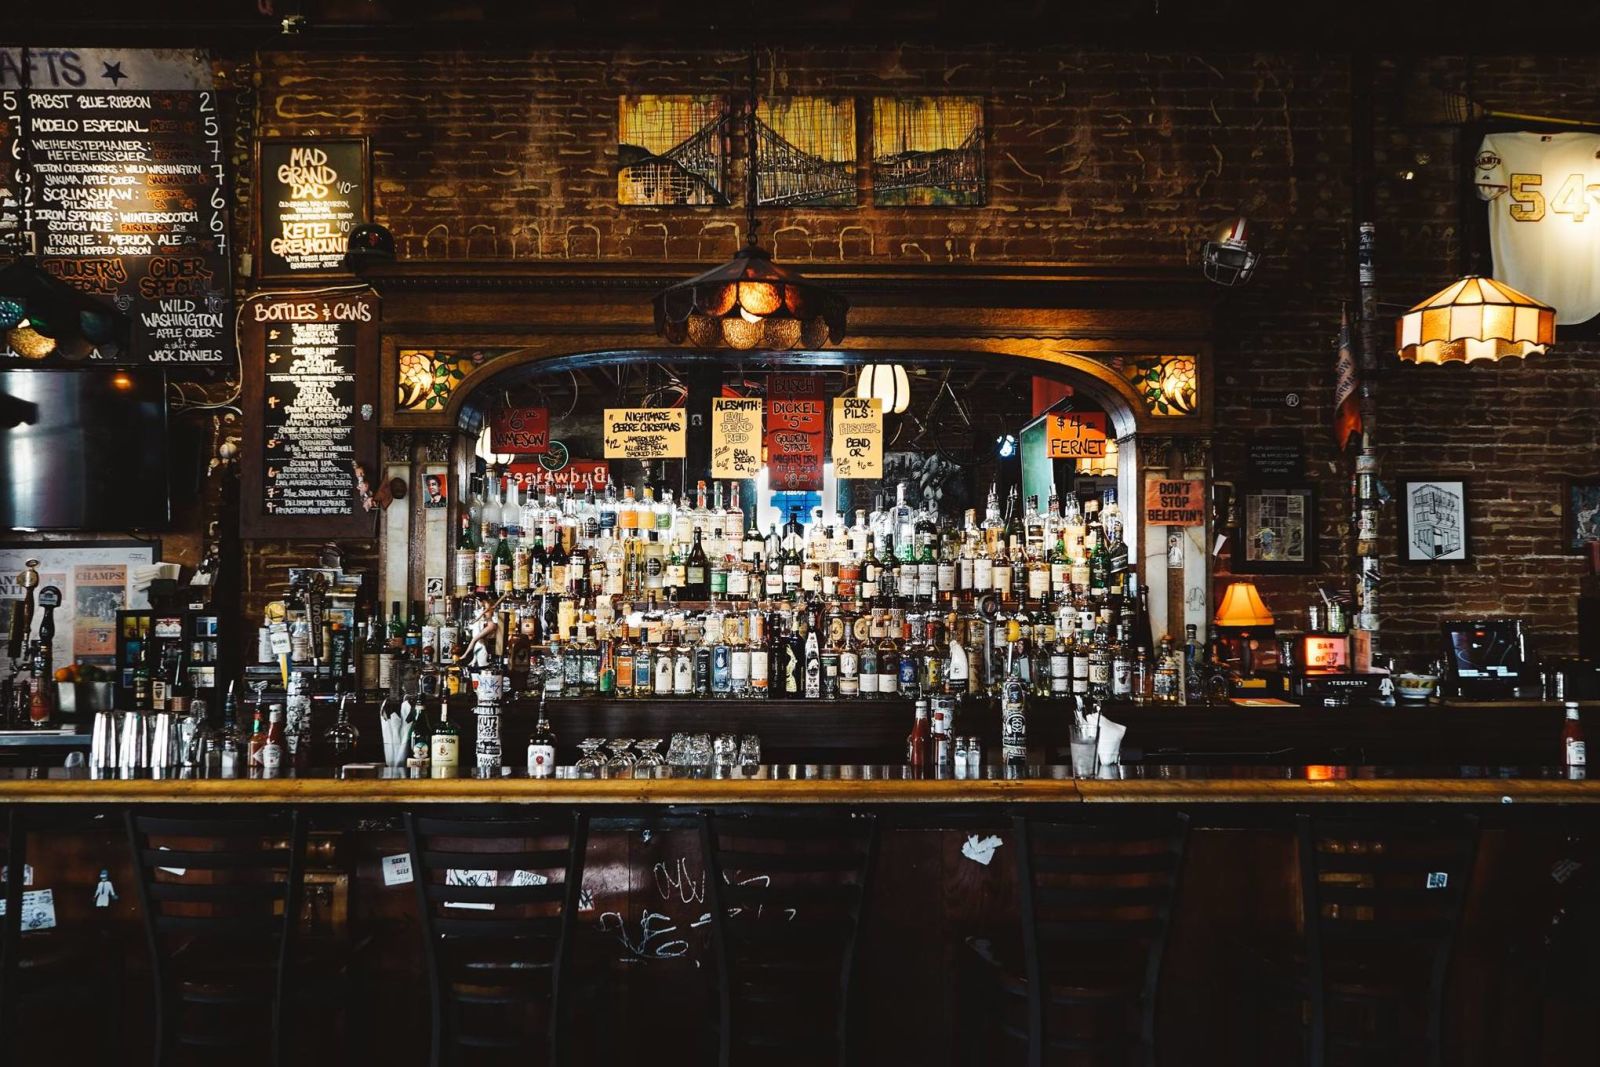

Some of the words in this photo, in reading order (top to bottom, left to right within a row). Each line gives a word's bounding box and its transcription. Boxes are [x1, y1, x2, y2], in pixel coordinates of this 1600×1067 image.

[28, 95, 73, 109] PABST
[77, 95, 107, 109] BLUE
[107, 94, 151, 109] RIBBON
[200, 92, 214, 112] 2
[31, 120, 79, 132] MODELO
[83, 120, 149, 133] ESPECIAL
[204, 117, 218, 136] 5
[47, 151, 152, 161] HEFEWEISSBIER
[206, 140, 221, 161] 7
[290, 148, 327, 167] MAD
[45, 174, 80, 186] YAKIMA
[83, 174, 109, 185] APPLE
[109, 175, 142, 186] CIDER
[125, 164, 146, 174] WILD
[147, 164, 201, 175] WASHINGTON
[211, 164, 224, 185] 7
[278, 164, 337, 185] GRAND
[291, 183, 328, 199] DAD
[211, 188, 225, 208] 6
[61, 200, 119, 210] PILSNER
[35, 210, 66, 220] IRON
[118, 211, 199, 223] WINTERSCOTCH
[209, 211, 224, 232] 6
[47, 221, 88, 232] SCOTCH
[90, 222, 114, 232] ALE
[282, 222, 342, 241] KETEL
[43, 246, 78, 255] NELSON
[80, 246, 115, 255] HOPPED
[117, 247, 151, 256] SAISON
[157, 234, 181, 246] ALE
[213, 234, 226, 255] 7
[148, 257, 213, 279] CIDER
[160, 299, 195, 312] WILD
[254, 303, 319, 321] BOTTLES
[141, 313, 223, 328] WASHINGTON
[148, 350, 178, 361] JACK
[179, 350, 223, 361] DANIELS
[336, 405, 353, 414] CAN
[773, 402, 820, 416] DICKEL
[844, 399, 871, 411] CRUX
[625, 411, 671, 422] NIGHTMARE
[723, 411, 749, 422] EVIL
[612, 422, 640, 433] BEFORE
[640, 422, 681, 433] CHRISTMAS
[719, 421, 754, 434] DEAD
[725, 433, 750, 445] RED
[775, 434, 809, 445] GOLDEN
[782, 443, 812, 453] STATE
[1051, 439, 1106, 455] FERNET
[733, 449, 749, 459] SAN
[803, 454, 819, 464] DRY
[850, 449, 865, 459] OR
[735, 464, 745, 473] CA
[1160, 482, 1192, 495] DON'T
[1161, 496, 1190, 509] STOP
[76, 572, 125, 582] CHAMPS!
